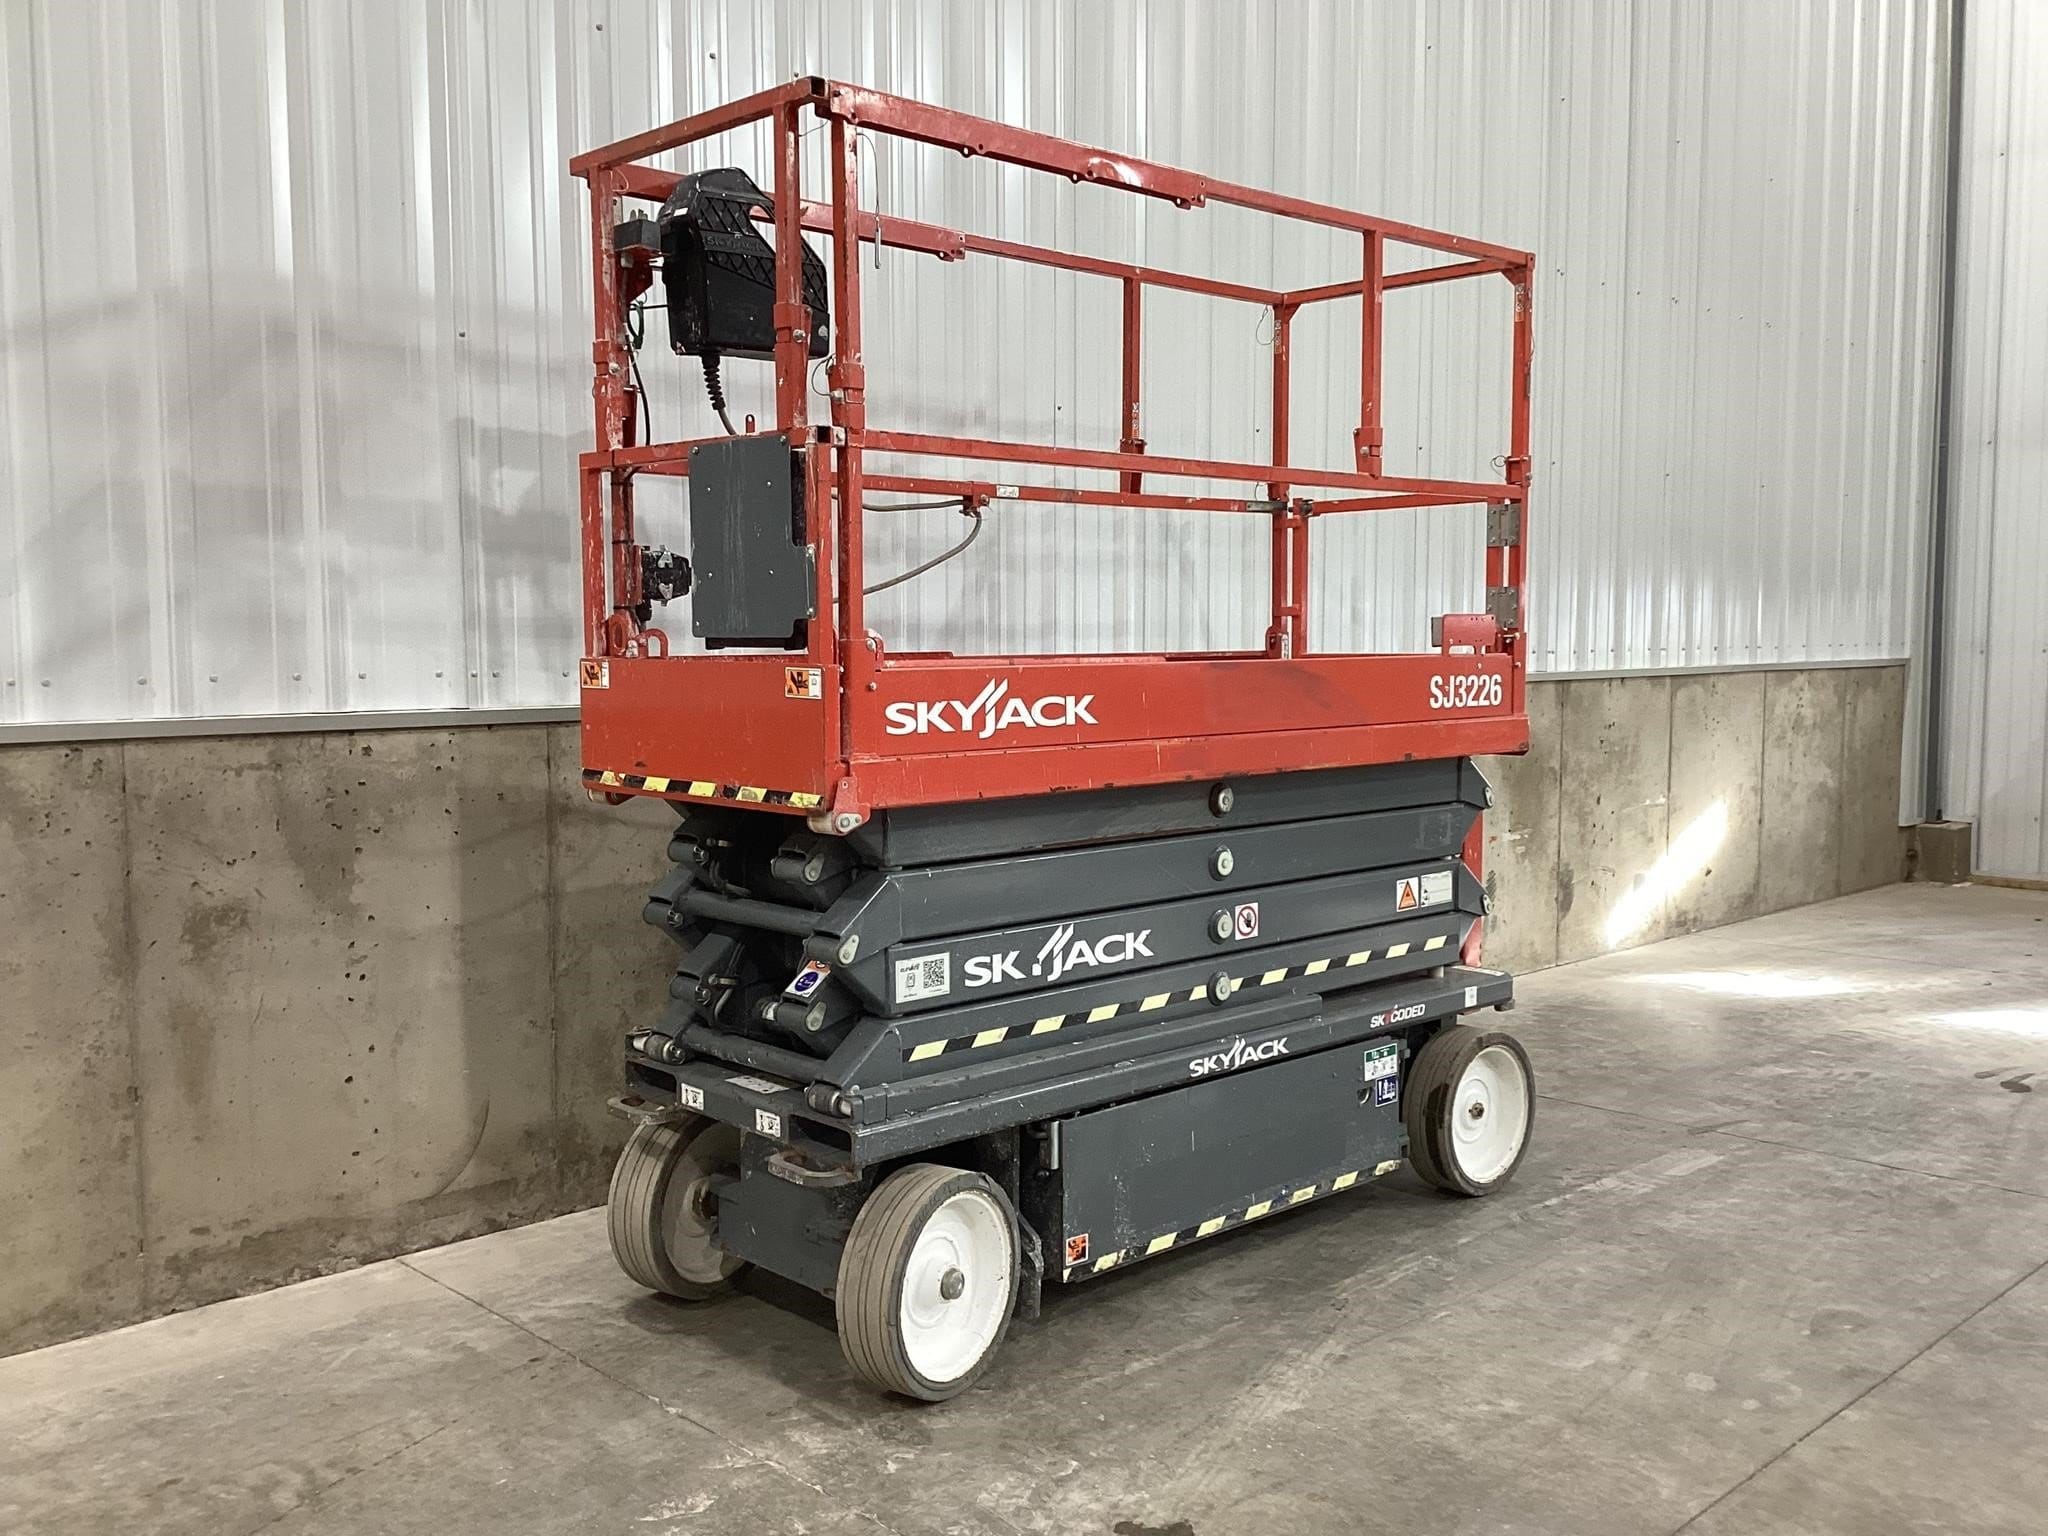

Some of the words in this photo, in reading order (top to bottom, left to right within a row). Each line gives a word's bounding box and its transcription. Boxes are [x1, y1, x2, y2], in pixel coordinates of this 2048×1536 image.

[885, 678, 1098, 739] SKYJACK
[1429, 674, 1502, 709] SJ3226
[1189, 1036, 1289, 1077] SKYJACK
